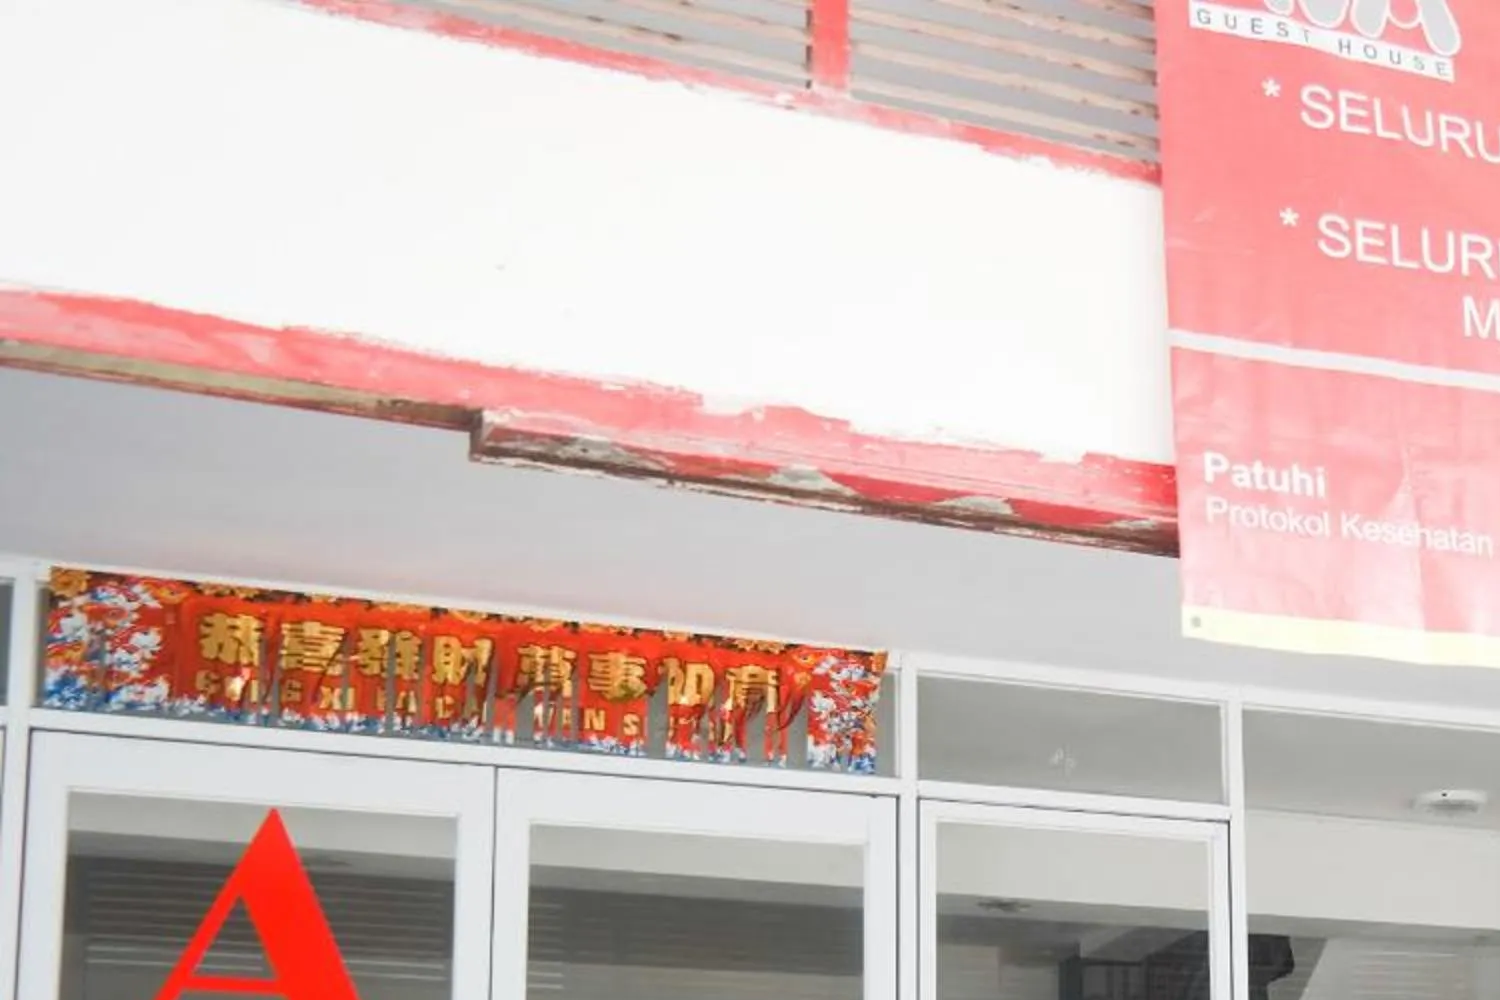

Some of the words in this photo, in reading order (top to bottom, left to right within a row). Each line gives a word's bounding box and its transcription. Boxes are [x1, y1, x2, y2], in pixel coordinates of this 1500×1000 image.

[1196, 8, 1311, 43] GUEST
[1338, 38, 1449, 77] HOUSE
[1202, 451, 1326, 498] Patuhi
[1206, 500, 1330, 539] Protokol
[1341, 514, 1493, 558] Kesehatan
